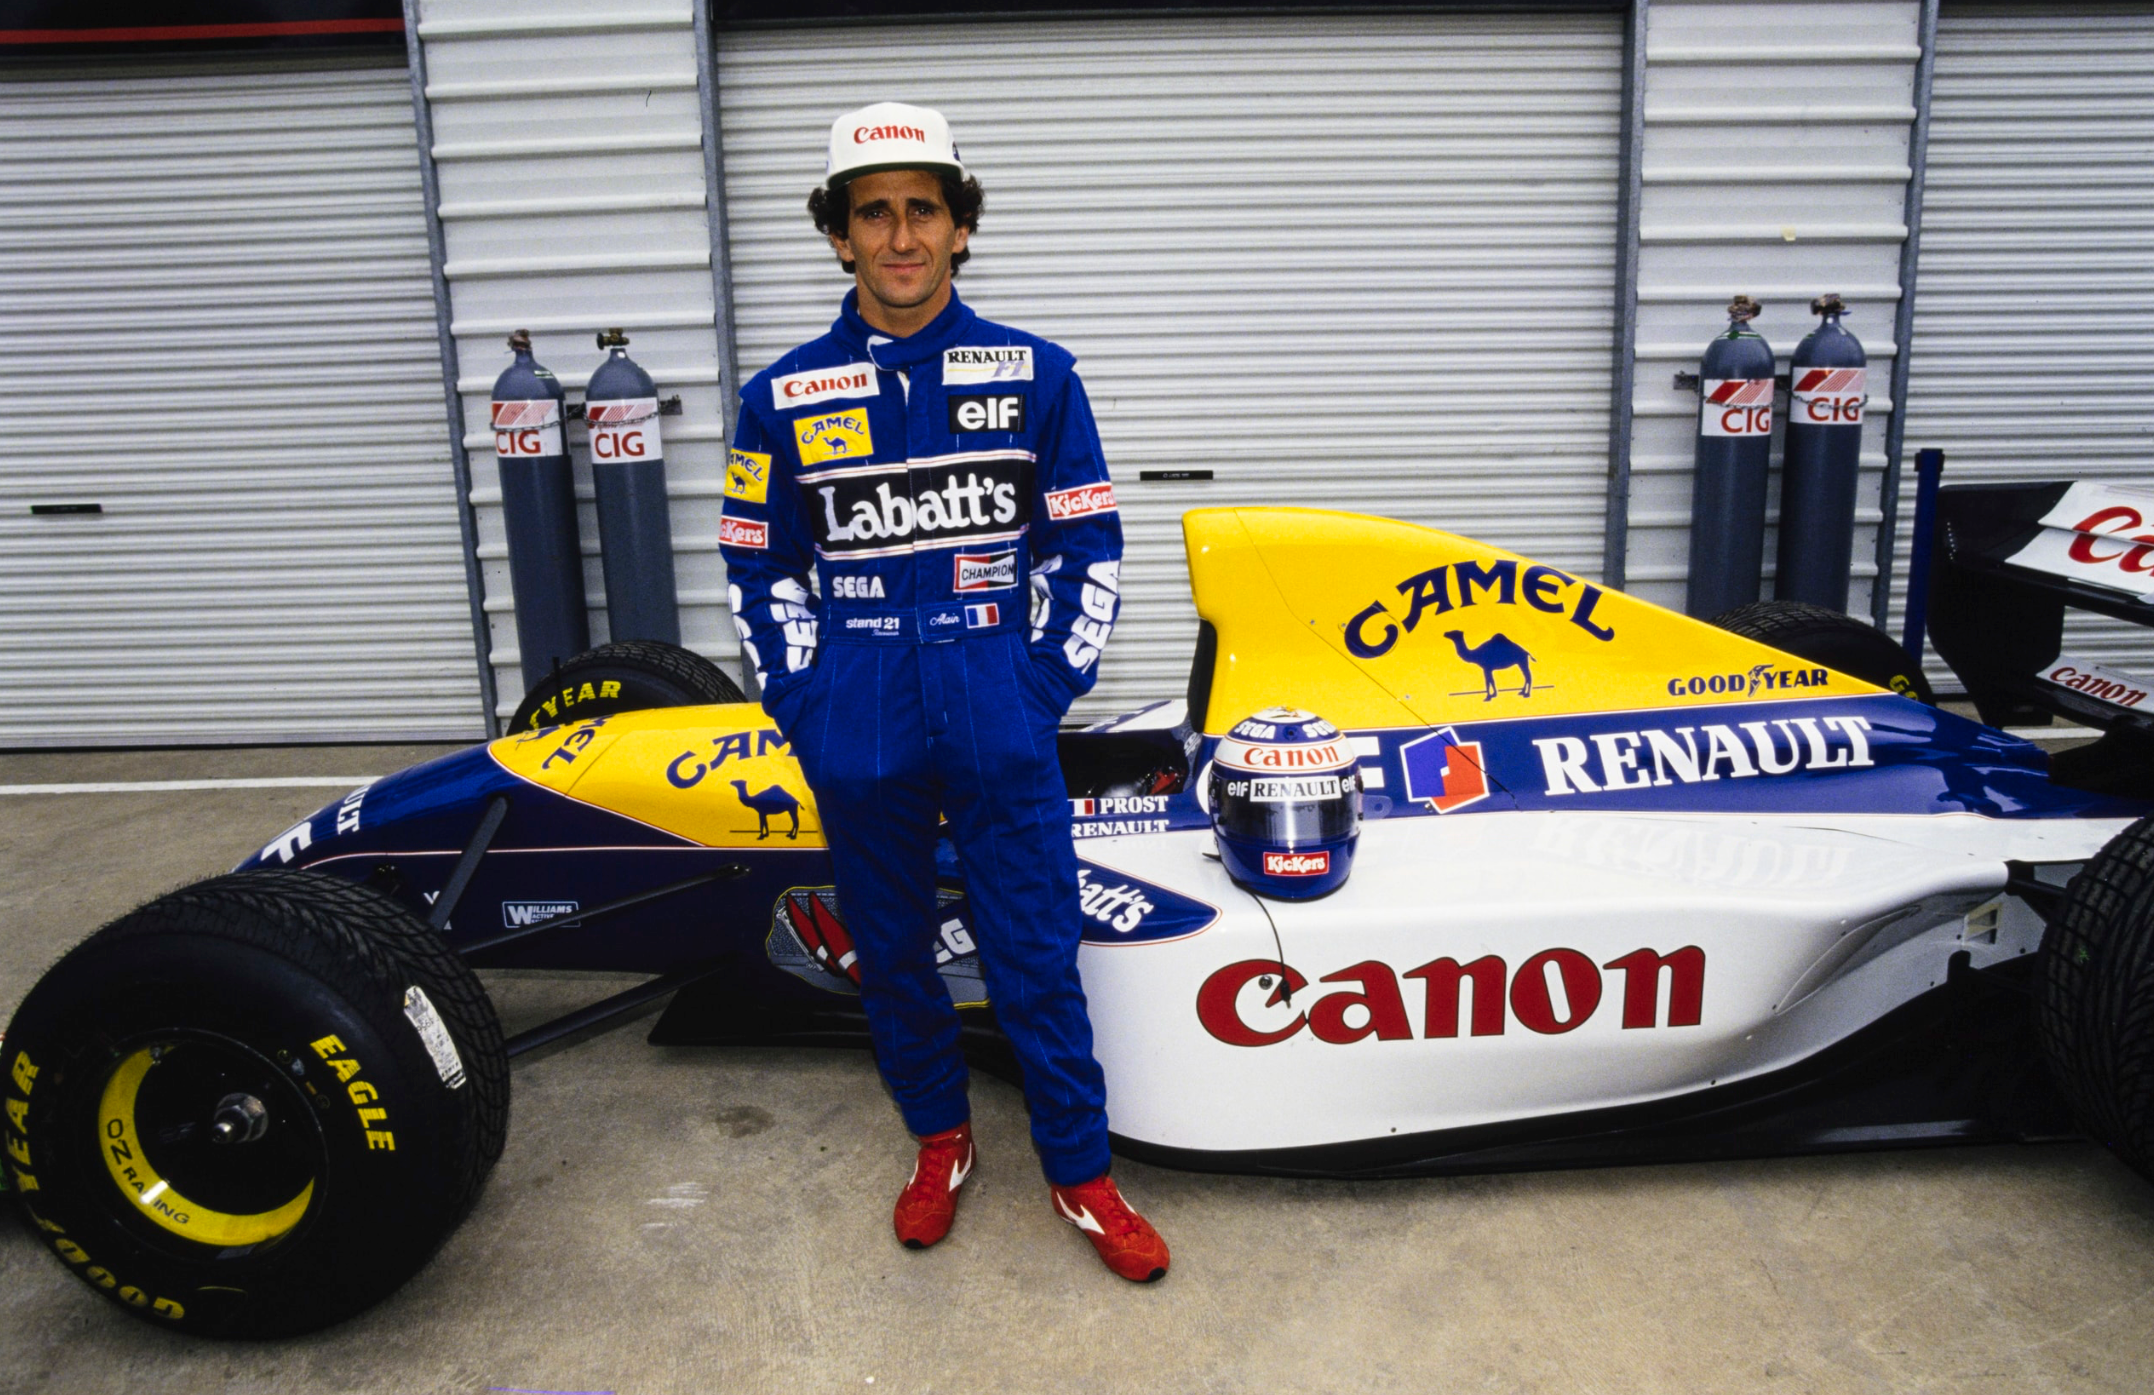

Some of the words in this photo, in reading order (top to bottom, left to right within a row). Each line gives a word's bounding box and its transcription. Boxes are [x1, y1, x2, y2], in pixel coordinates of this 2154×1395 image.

[853, 125, 925, 144] Canon
[947, 350, 1027, 364] RENAULT
[993, 358, 1025, 377] F1
[783, 372, 868, 398] Canon
[957, 397, 1019, 430] elf
[1721, 408, 1770, 433] CIG
[1808, 397, 1860, 421] CIG
[495, 429, 541, 454] CIG
[801, 415, 865, 444] CAMEL
[594, 431, 645, 458] CIG
[818, 472, 1017, 542] Labatt's
[962, 560, 1015, 581] CHAMPION
[832, 575, 886, 598] SEGA
[1063, 560, 1121, 675] SEGA
[1344, 559, 1615, 658] CAMEL
[846, 617, 882, 629] stand
[884, 617, 900, 630] 21
[2050, 666, 2148, 707] Canon
[1234, 720, 1277, 739] SEGA
[666, 729, 800, 789] CAM
[1244, 745, 1340, 767] Canon
[1531, 715, 1875, 796] RENAULT
[1227, 781, 1249, 797] elf
[1253, 780, 1338, 797] RENAULT
[1100, 795, 1169, 815] PROST
[1072, 819, 1170, 838] RENAULT
[507, 905, 573, 925] WILLIAMS
[1196, 945, 1706, 1047] Canon
[311, 1034, 396, 1152] EAGLE
[123, 1166, 190, 1224] RAING
